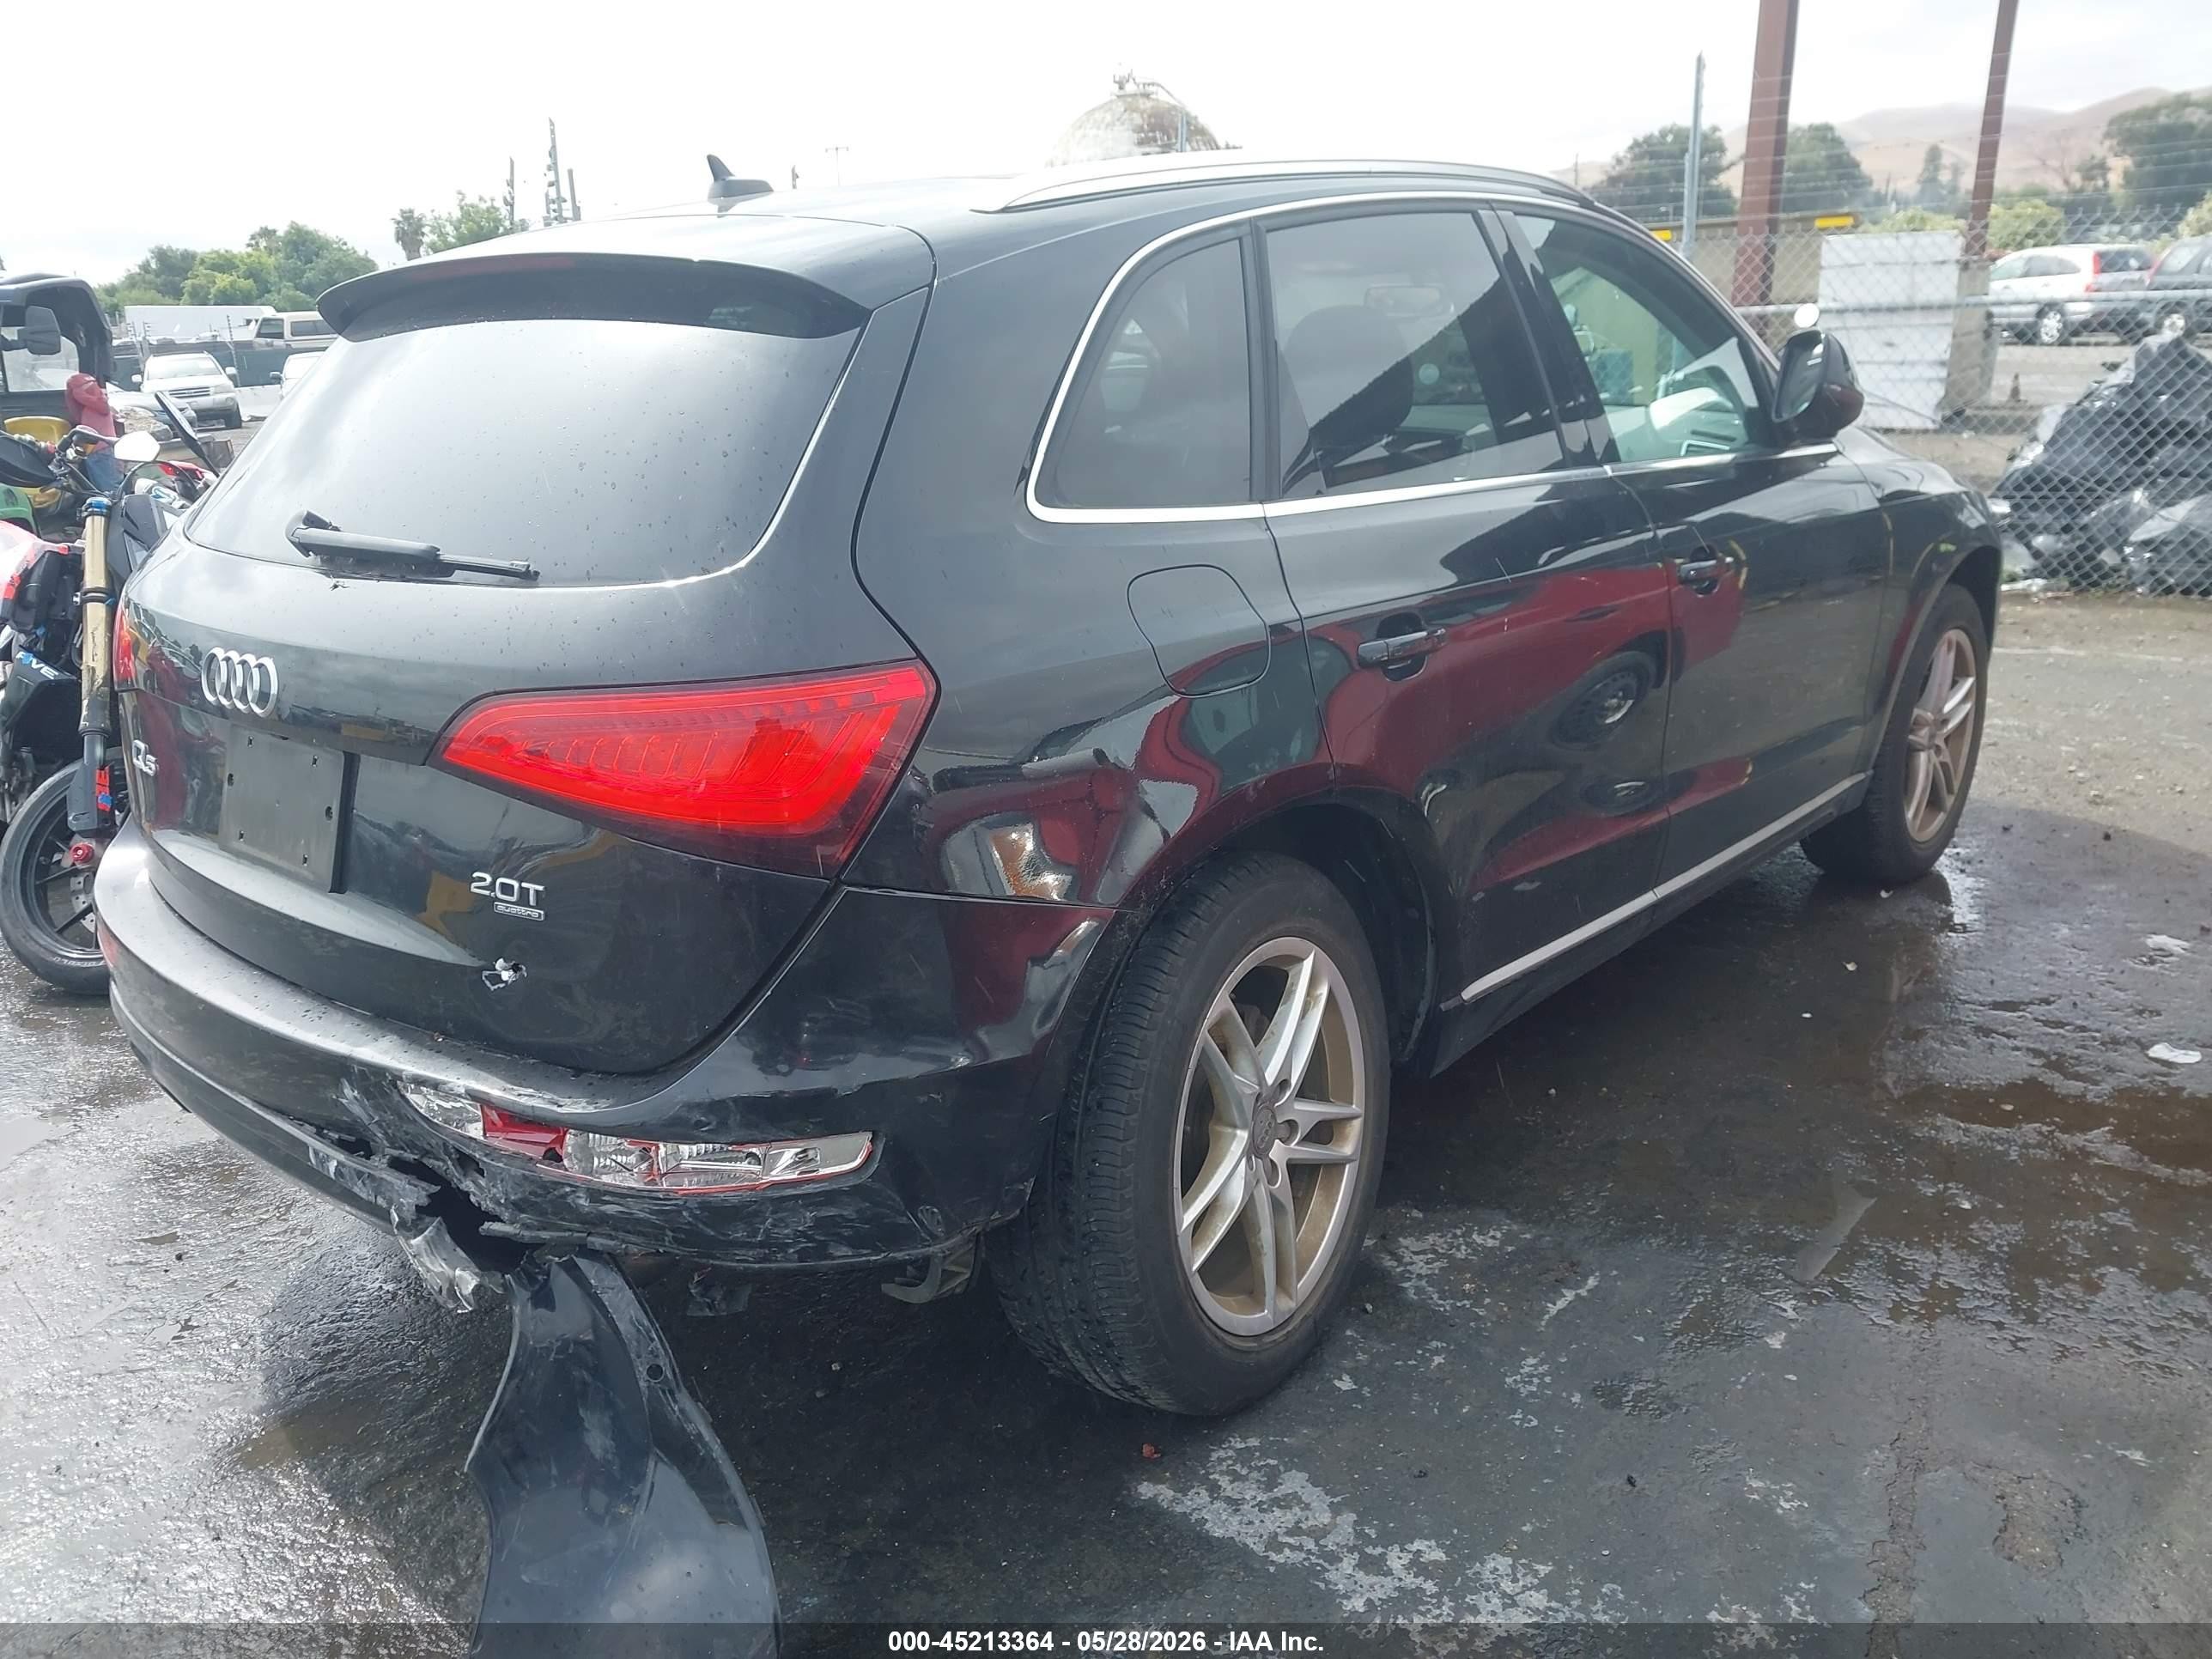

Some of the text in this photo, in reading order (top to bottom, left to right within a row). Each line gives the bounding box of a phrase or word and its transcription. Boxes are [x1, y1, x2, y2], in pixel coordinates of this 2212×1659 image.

[131, 739, 156, 777] Q5
[470, 872, 545, 906] 2.0T
[495, 904, 539, 918] quattro
